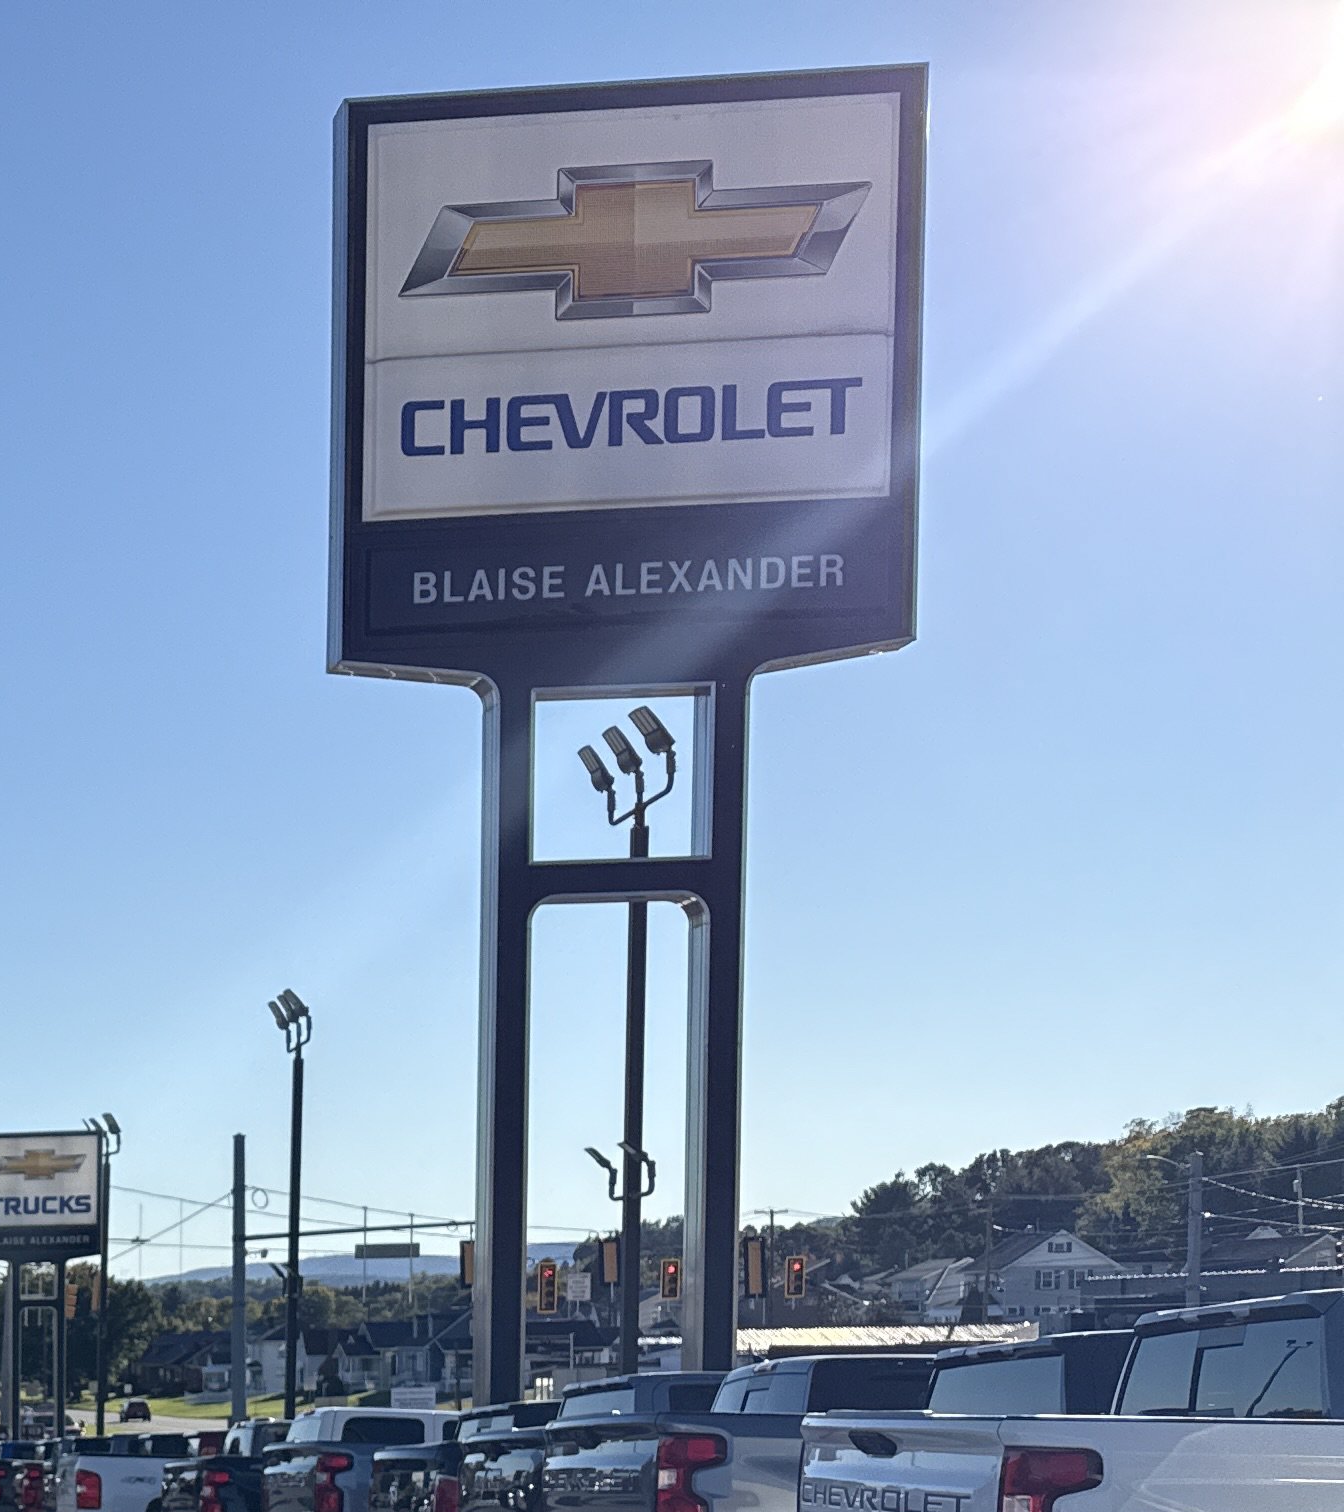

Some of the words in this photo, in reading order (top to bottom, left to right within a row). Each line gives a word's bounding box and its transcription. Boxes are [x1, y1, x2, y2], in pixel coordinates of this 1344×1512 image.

[399, 376, 864, 457] CHEVROLET
[412, 564, 565, 605] BLAISE
[584, 553, 845, 599] ALEXANDER
[31, 1234, 90, 1245] ALEXANDER
